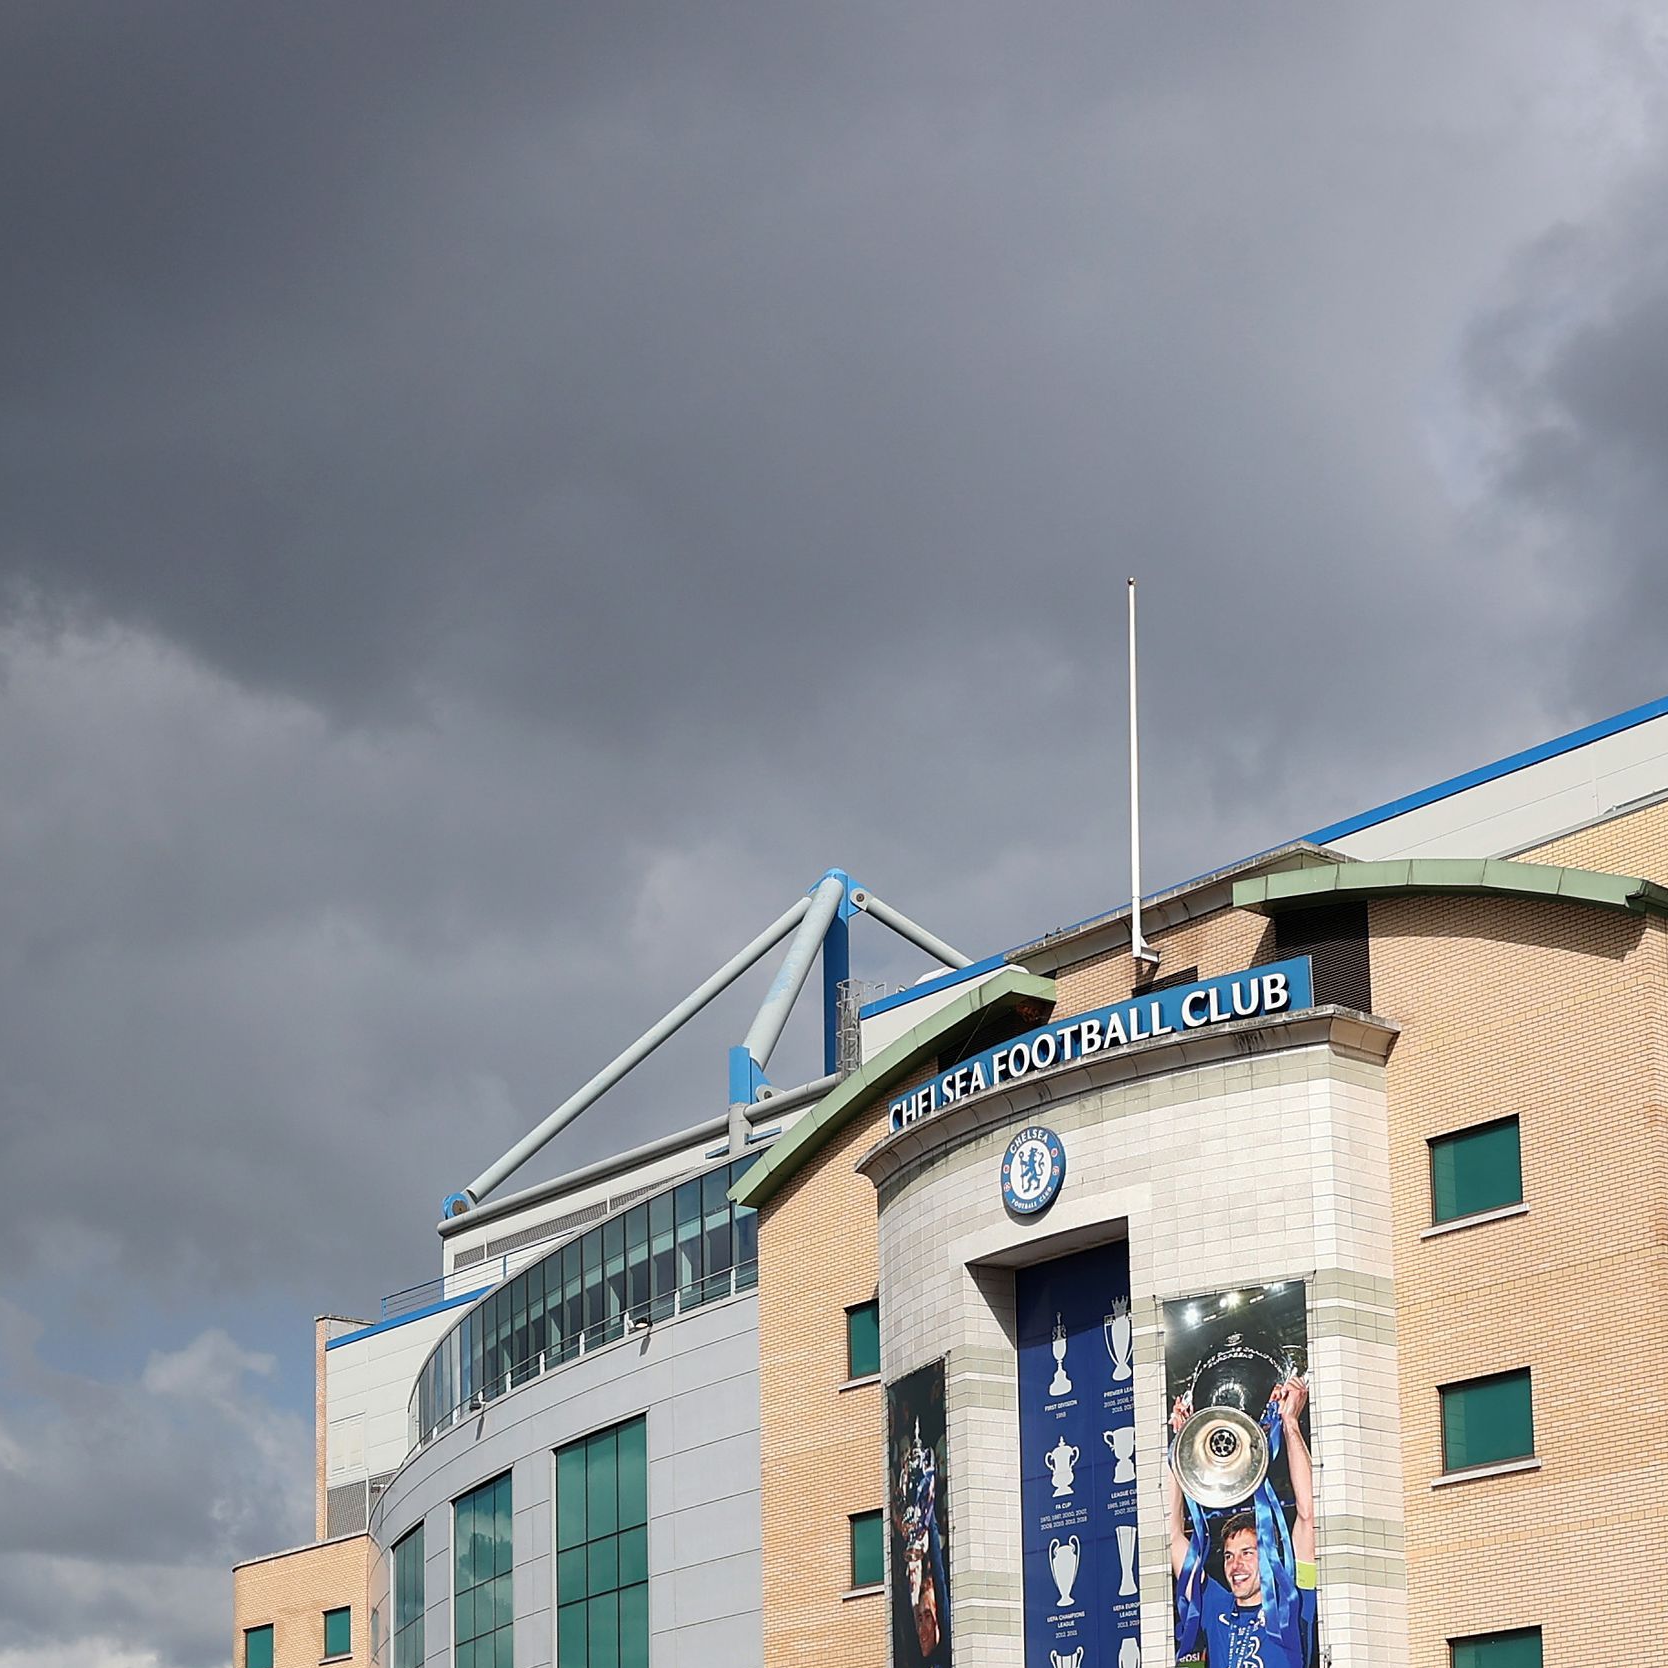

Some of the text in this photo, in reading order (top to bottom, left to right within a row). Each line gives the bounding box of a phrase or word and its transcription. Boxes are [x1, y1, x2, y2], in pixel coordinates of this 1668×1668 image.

[992, 1001, 1173, 1085] FOOTBALL
[1181, 972, 1290, 1028] CLUB
[1009, 1128, 1050, 1154] CHELSEA
